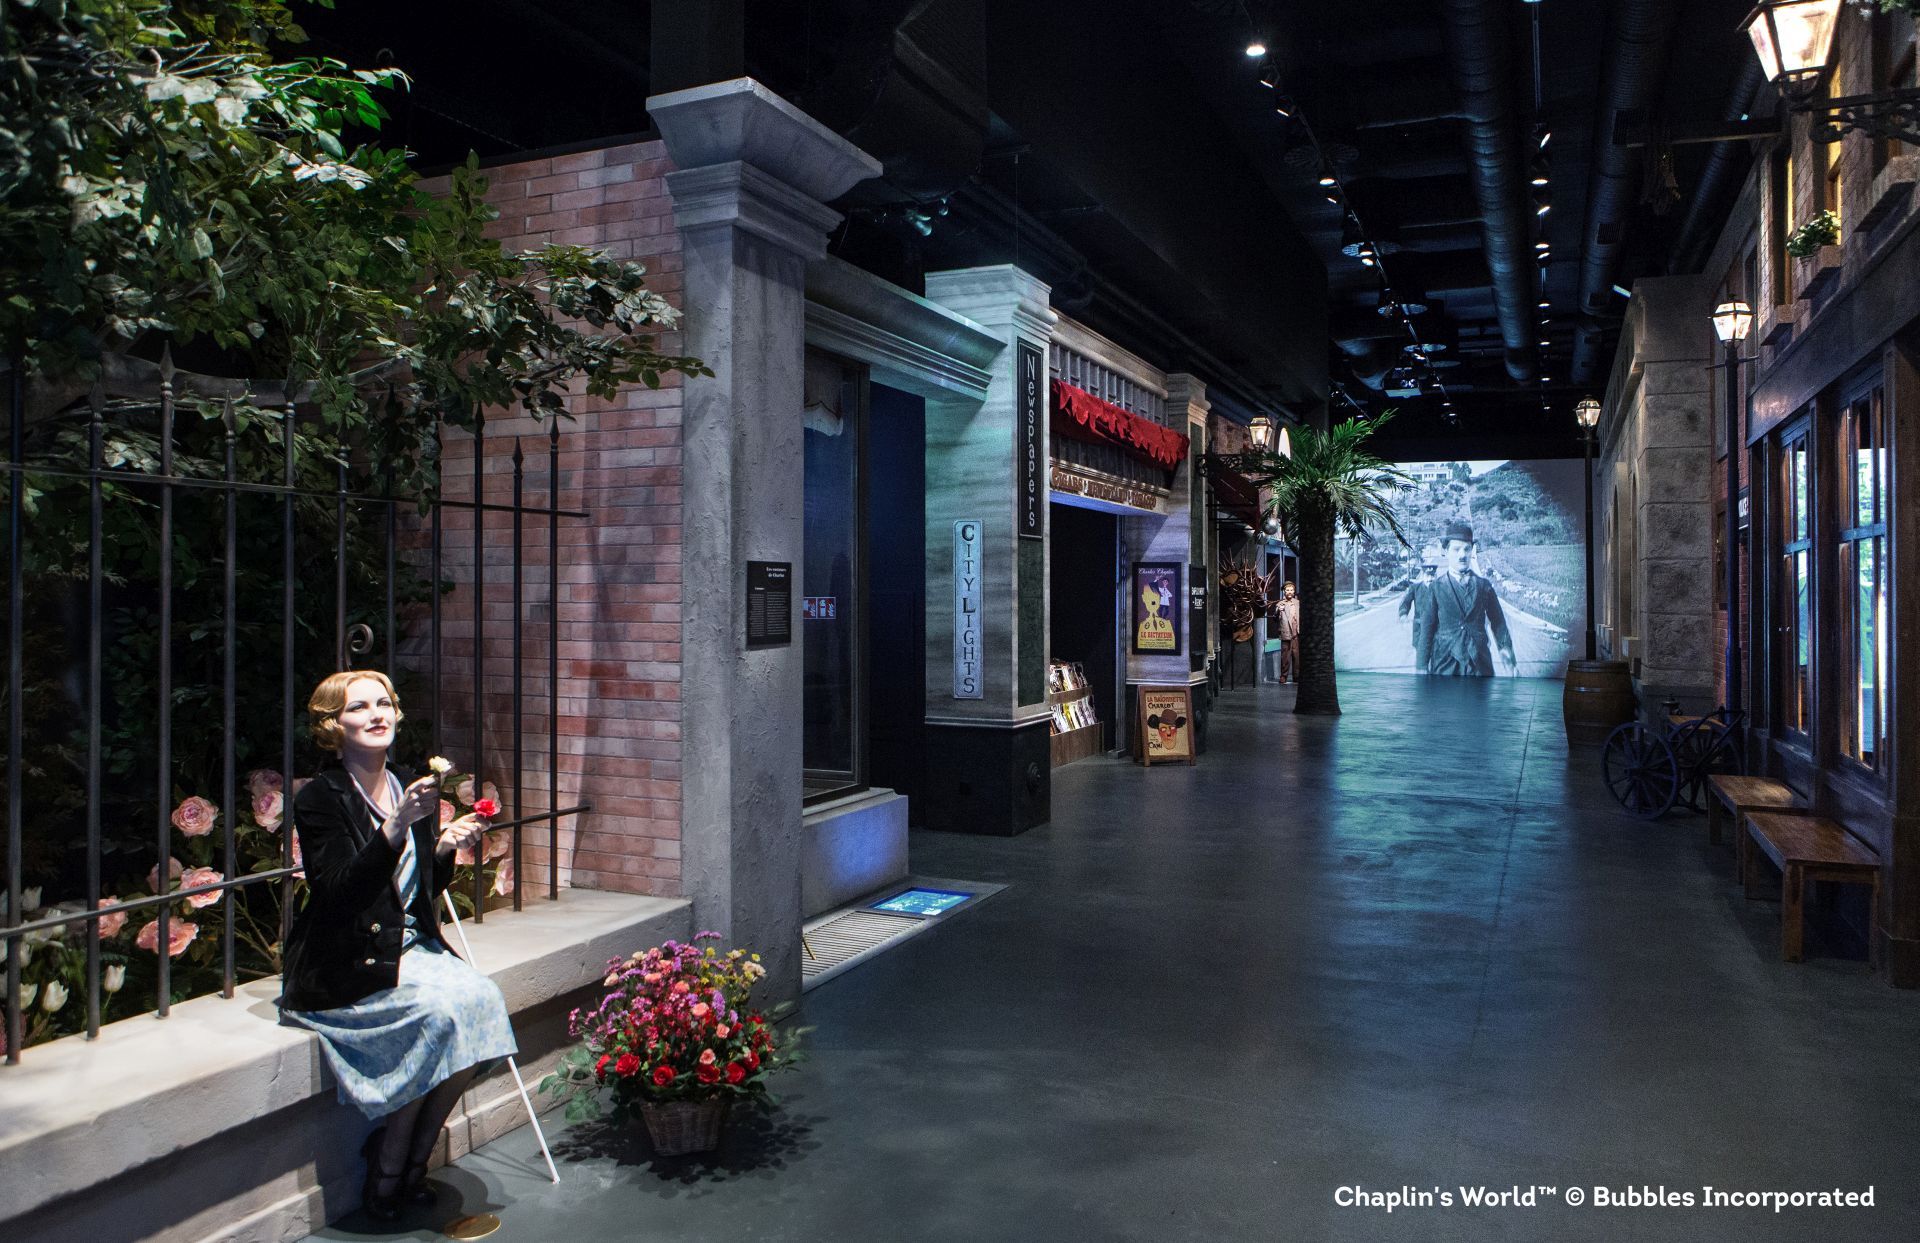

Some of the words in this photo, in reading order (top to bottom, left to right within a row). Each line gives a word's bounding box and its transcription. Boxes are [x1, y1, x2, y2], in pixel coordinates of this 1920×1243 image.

[1026, 354, 1035, 527] Newspapers
[961, 524, 976, 592] CITY
[962, 597, 976, 693] LIGHTS
